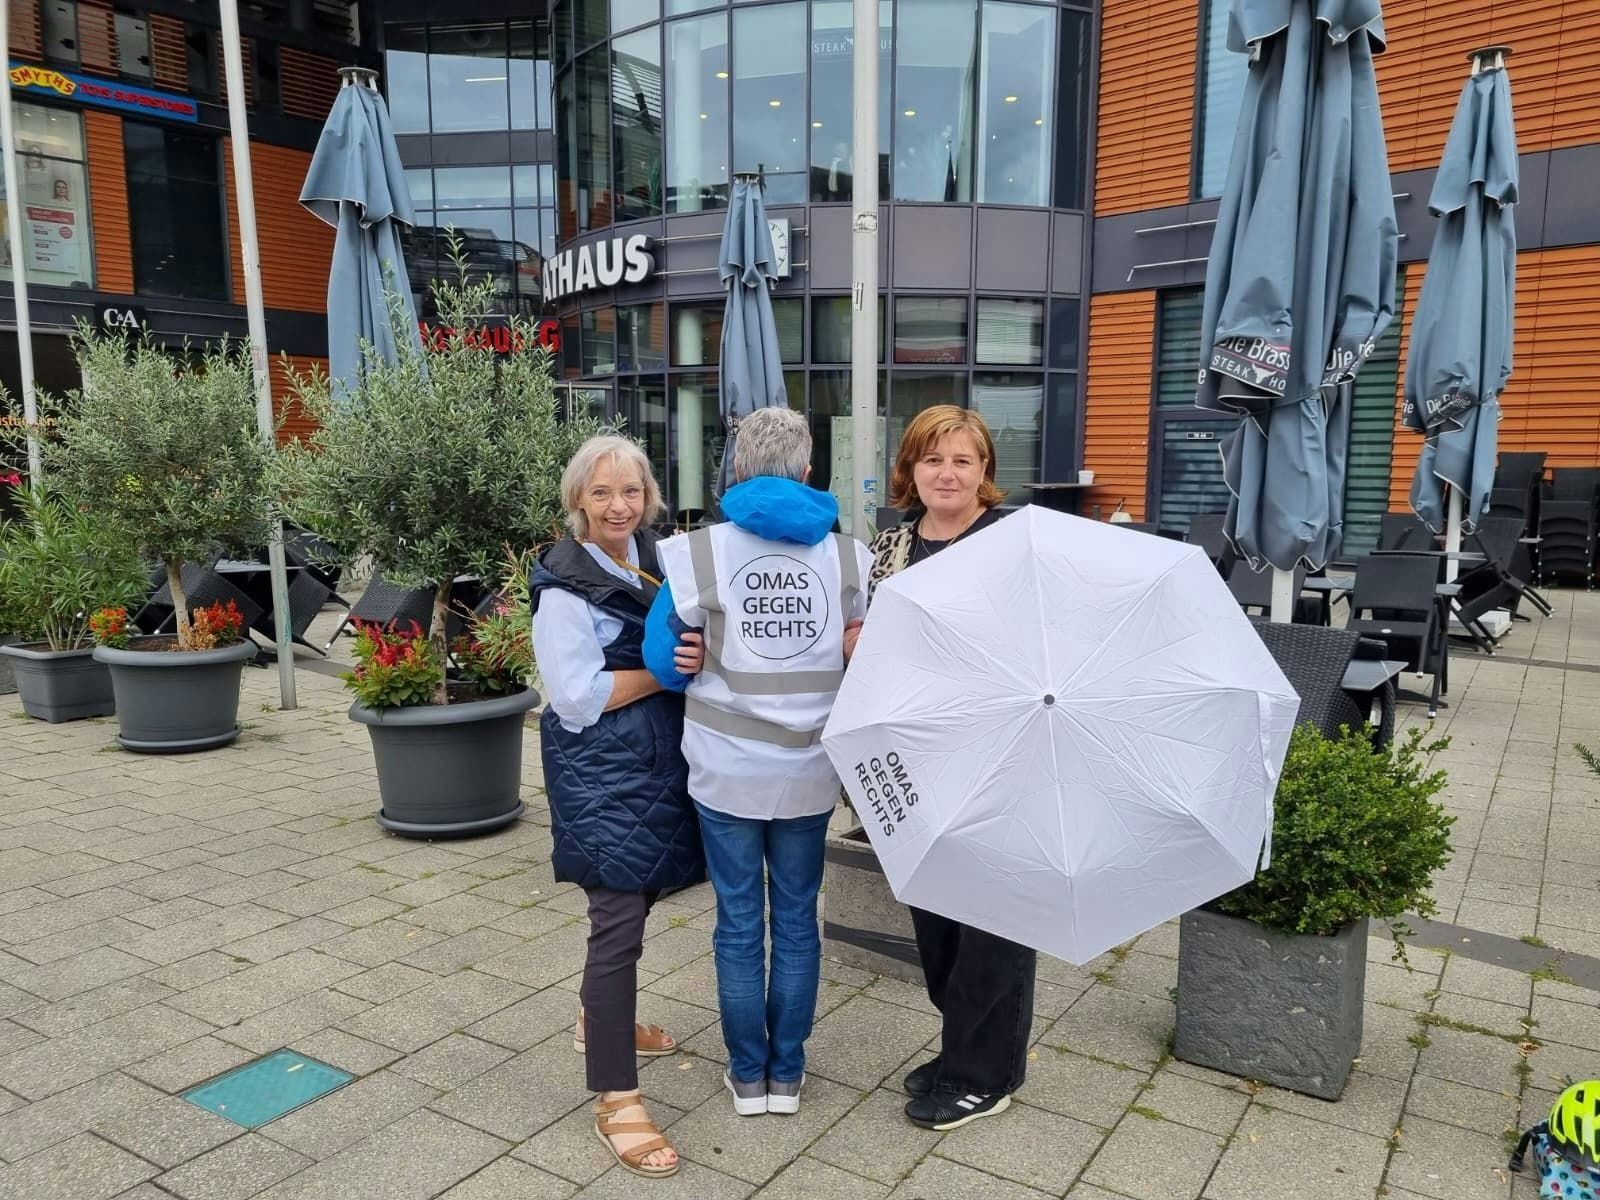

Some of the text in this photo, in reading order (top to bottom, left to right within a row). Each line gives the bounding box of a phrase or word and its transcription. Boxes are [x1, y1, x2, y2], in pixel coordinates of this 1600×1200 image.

[814, 42, 846, 53] STEAK
[10, 69, 74, 93] SMYTHS
[103, 308, 140, 328] C&A
[1212, 355, 1252, 378] STEAK
[745, 572, 809, 590] OMAS
[743, 596, 812, 615] GEGEN
[741, 620, 817, 639] RECHTS
[870, 757, 907, 823] GEGEN
[886, 752, 919, 807] OMAS
[855, 761, 895, 837] RECHTS
